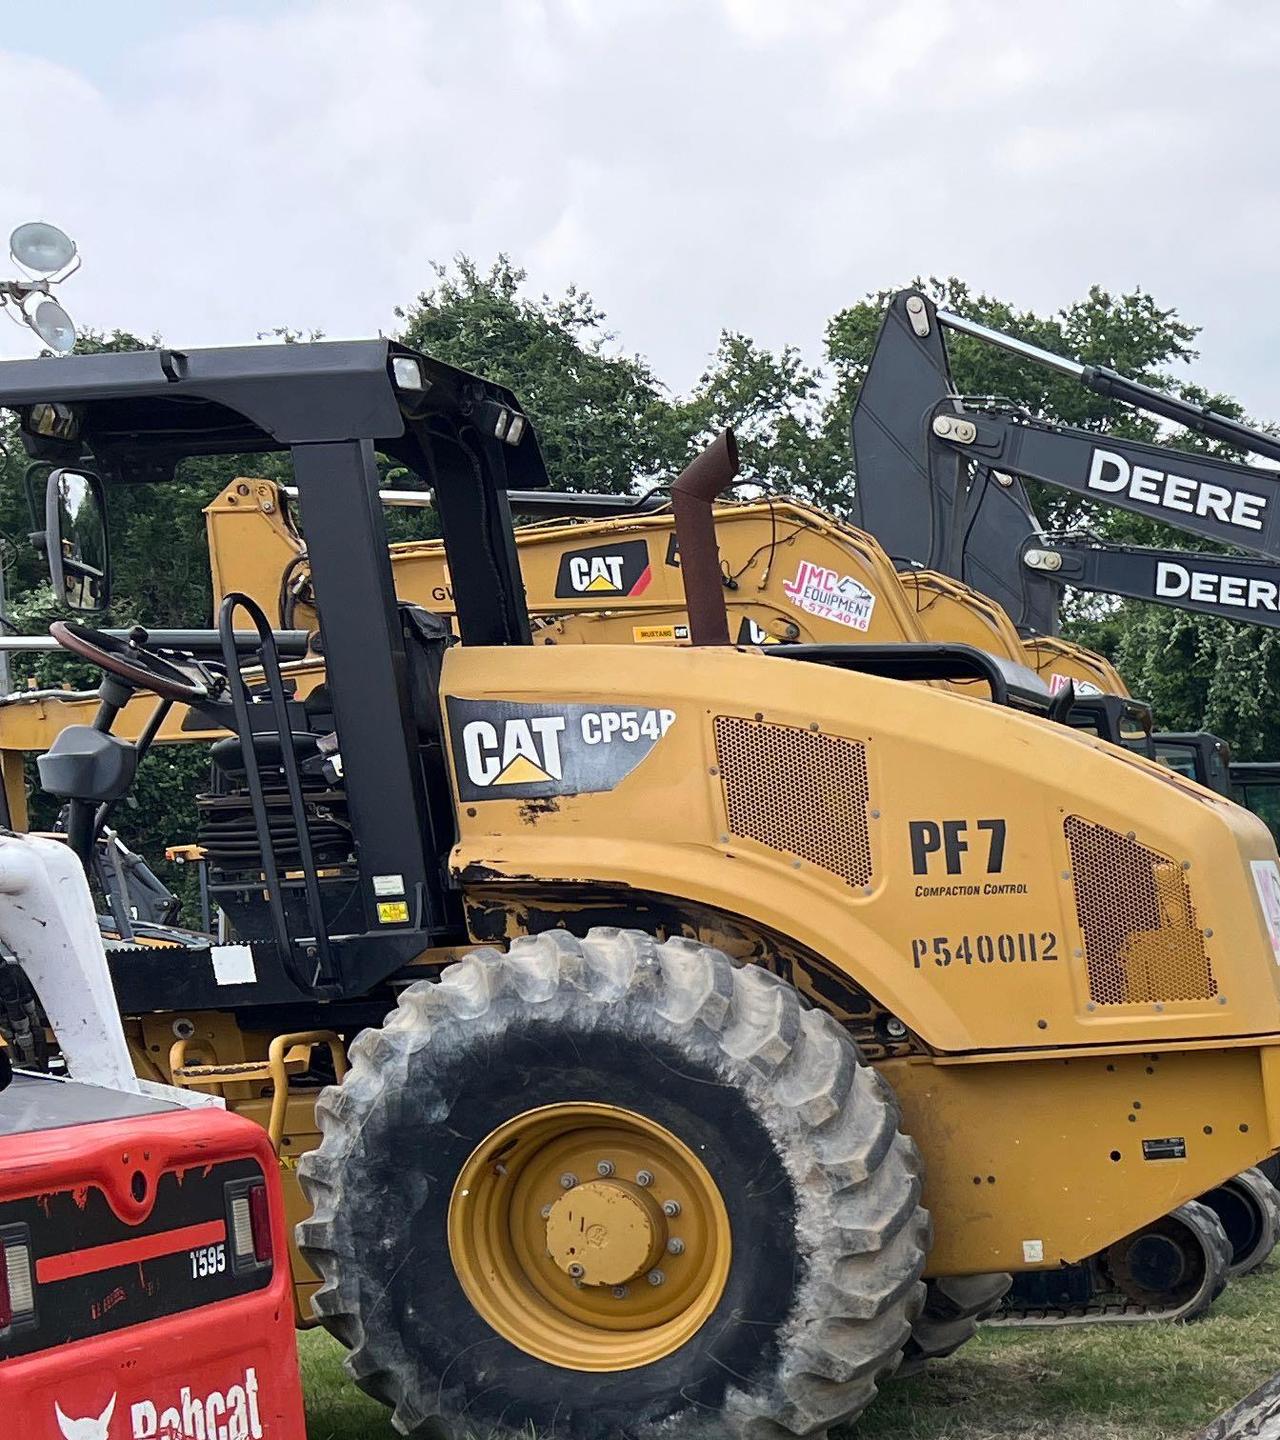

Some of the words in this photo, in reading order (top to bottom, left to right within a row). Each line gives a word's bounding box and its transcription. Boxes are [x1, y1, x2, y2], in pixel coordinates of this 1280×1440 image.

[1088, 448, 1267, 531] DEERE
[569, 556, 624, 592] CAT
[783, 563, 838, 594] JMC
[789, 596, 867, 629] 1-577-4016
[803, 585, 870, 618] EQUIPMENT
[462, 716, 566, 787] CAT
[915, 885, 980, 897] COMPACTION
[983, 883, 1029, 895] CONTROL
[911, 931, 1058, 969] P5400112
